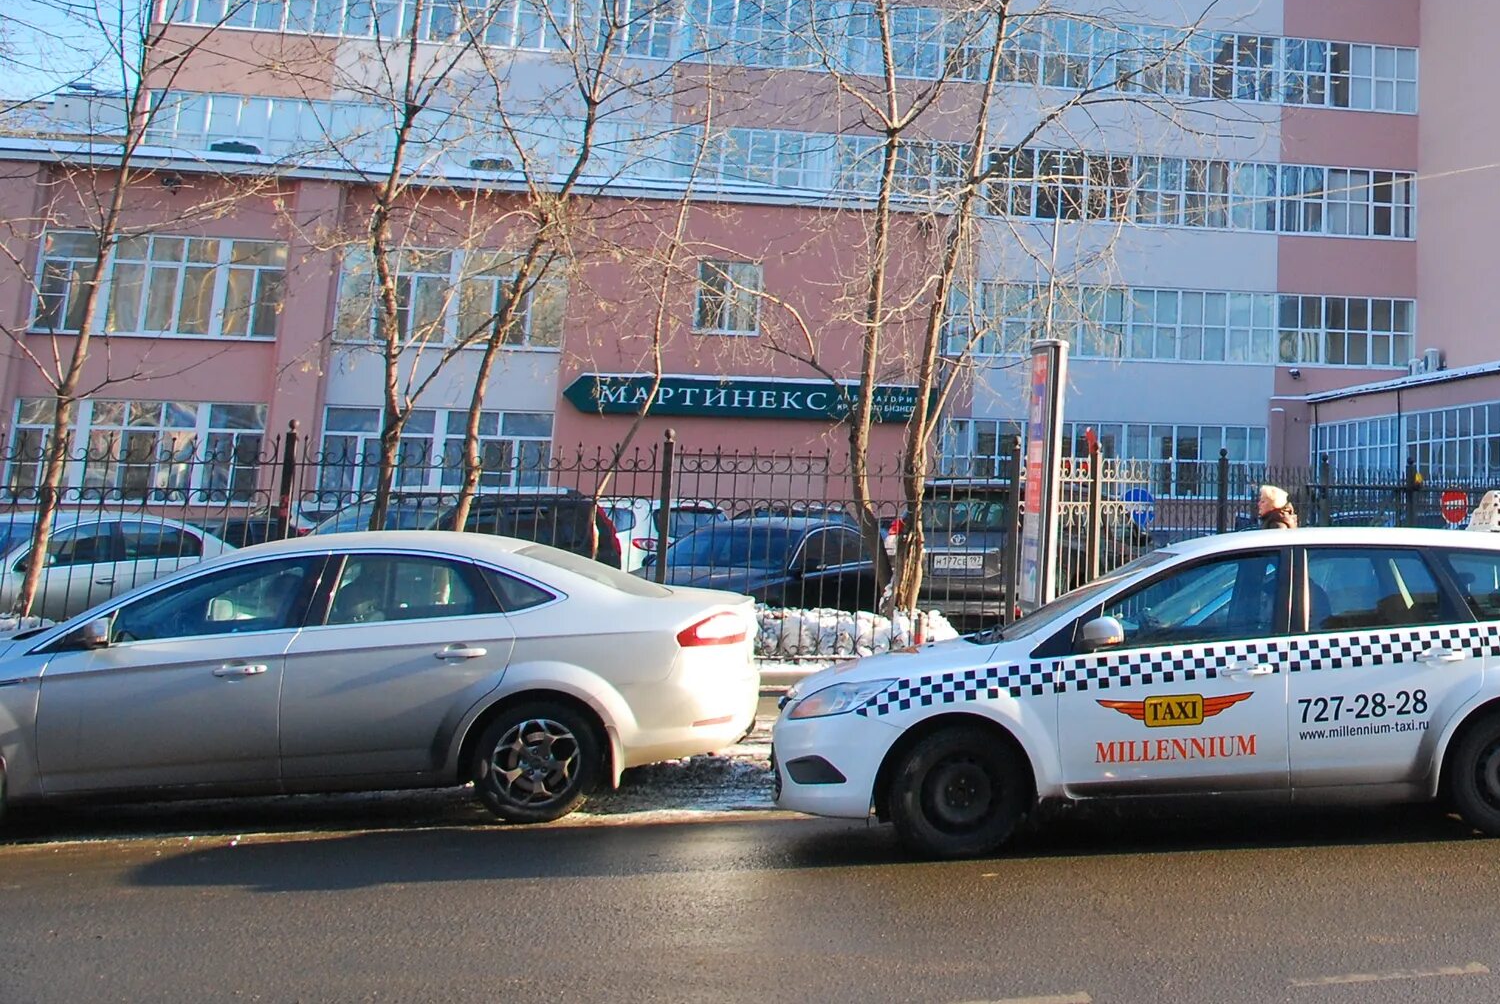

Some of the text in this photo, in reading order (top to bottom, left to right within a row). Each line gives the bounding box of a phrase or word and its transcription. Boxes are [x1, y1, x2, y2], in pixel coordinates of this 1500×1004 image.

[600, 385, 827, 410] МАРТИНЕКС
[1149, 700, 1198, 721] TAXI
[1298, 689, 1428, 723] 727-28-28
[1299, 719, 1430, 741] www.millennium-taxi.ru
[1095, 734, 1257, 763] MILLENNIUM
